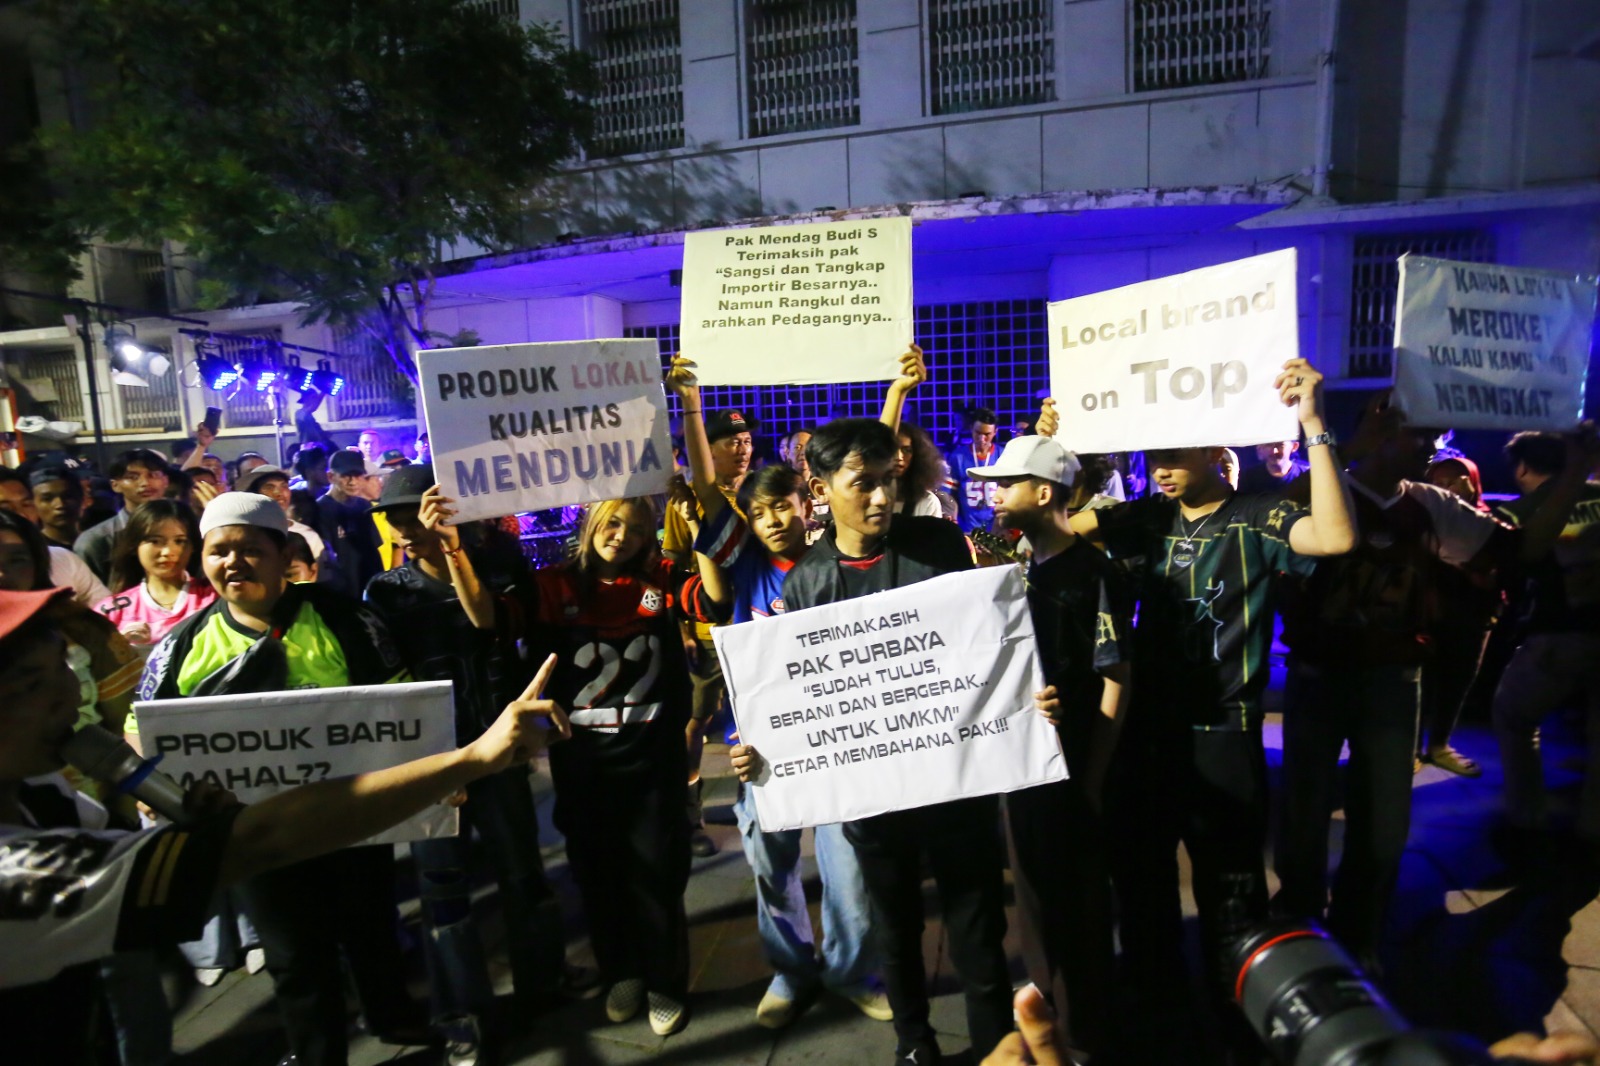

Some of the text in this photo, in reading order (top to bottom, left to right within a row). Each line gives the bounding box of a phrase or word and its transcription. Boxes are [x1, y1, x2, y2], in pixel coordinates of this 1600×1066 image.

[725, 227, 878, 247] Pak Mendag Budi S
[737, 245, 859, 261] Terimaksih pak
[780, 263, 810, 276] dan
[815, 260, 885, 275] Tangkap
[1453, 267, 1510, 294] KAYA
[718, 293, 881, 311] Namun Rangkul dan
[721, 278, 878, 296] Importir Besarnya..
[702, 312, 892, 329] arahkan Pedagangnya..
[1061, 281, 1276, 349] Local brand
[1428, 345, 1484, 368] KALAU
[1488, 350, 1534, 372] KAMU
[437, 360, 655, 401] PRODUK LOKAL
[1081, 358, 1248, 412] on Top
[1434, 383, 1553, 418] NGANGKAT
[488, 402, 622, 440] KUALITAS
[454, 438, 662, 498] MENDUNIA
[796, 608, 920, 649] TERIMAKASIH
[785, 630, 946, 681] PAK PURBAYA
[875, 658, 941, 684] TULUS,
[569, 635, 662, 726] 22
[769, 673, 989, 730] BERANI DAN BERGERAK..
[154, 719, 421, 756] PRODUK BARU
[773, 717, 1010, 778] CETAR MEMBAHANA PAK!!!
[807, 719, 879, 748] UNTUK
